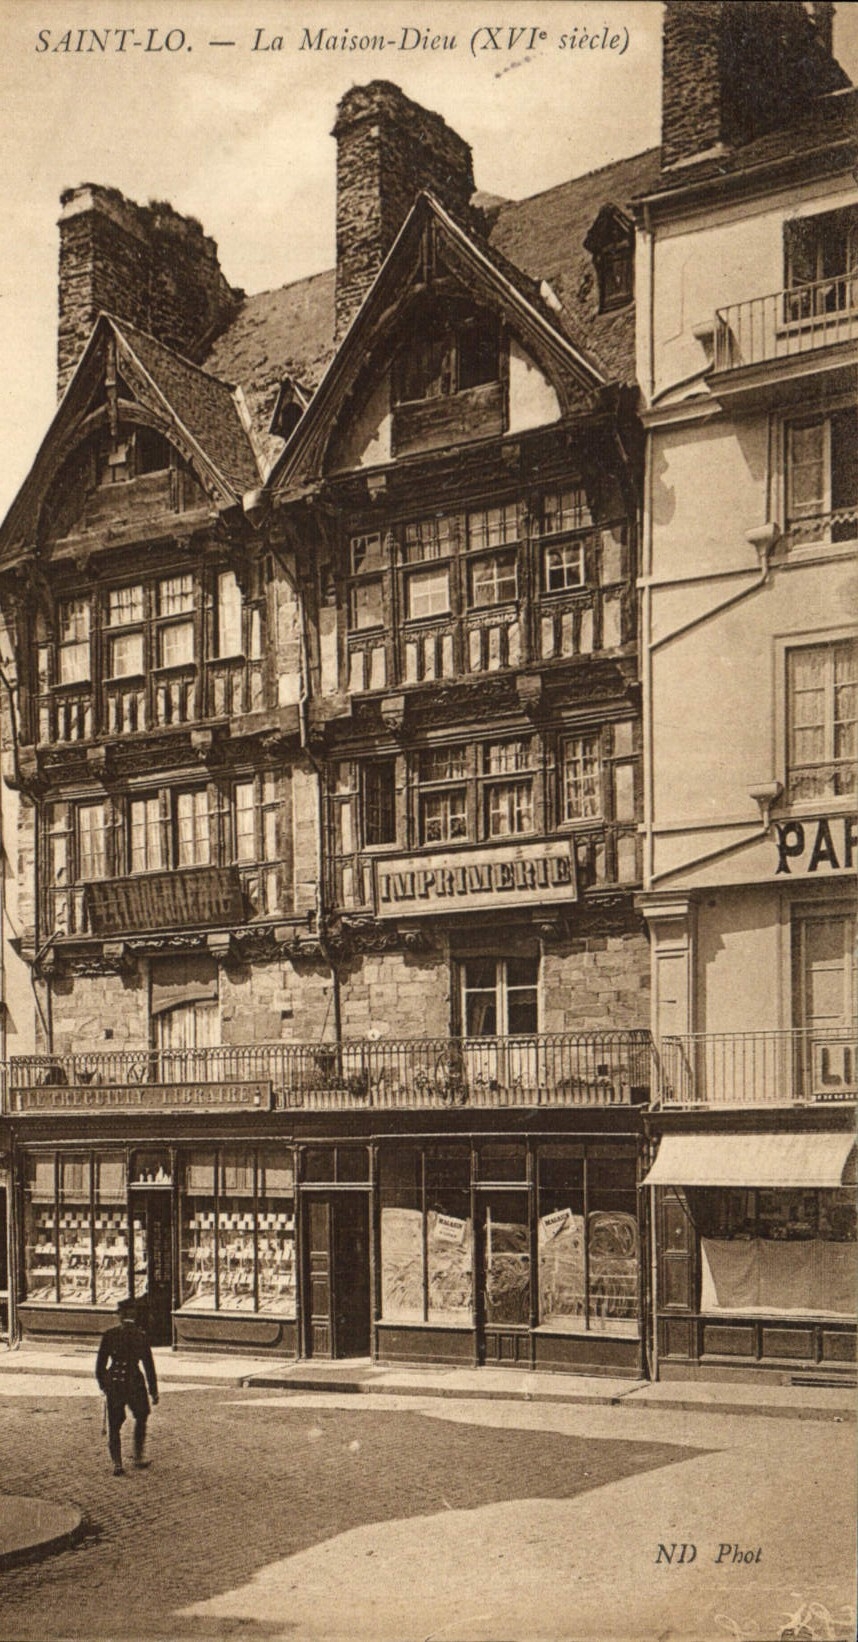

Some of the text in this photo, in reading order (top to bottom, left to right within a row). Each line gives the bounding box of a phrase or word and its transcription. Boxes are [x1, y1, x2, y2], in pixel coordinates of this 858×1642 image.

[379, 857, 570, 903] IMPRIMERIE
[821, 1046, 858, 1086] LI
[162, 1086, 250, 1105] LIBRAIRE
